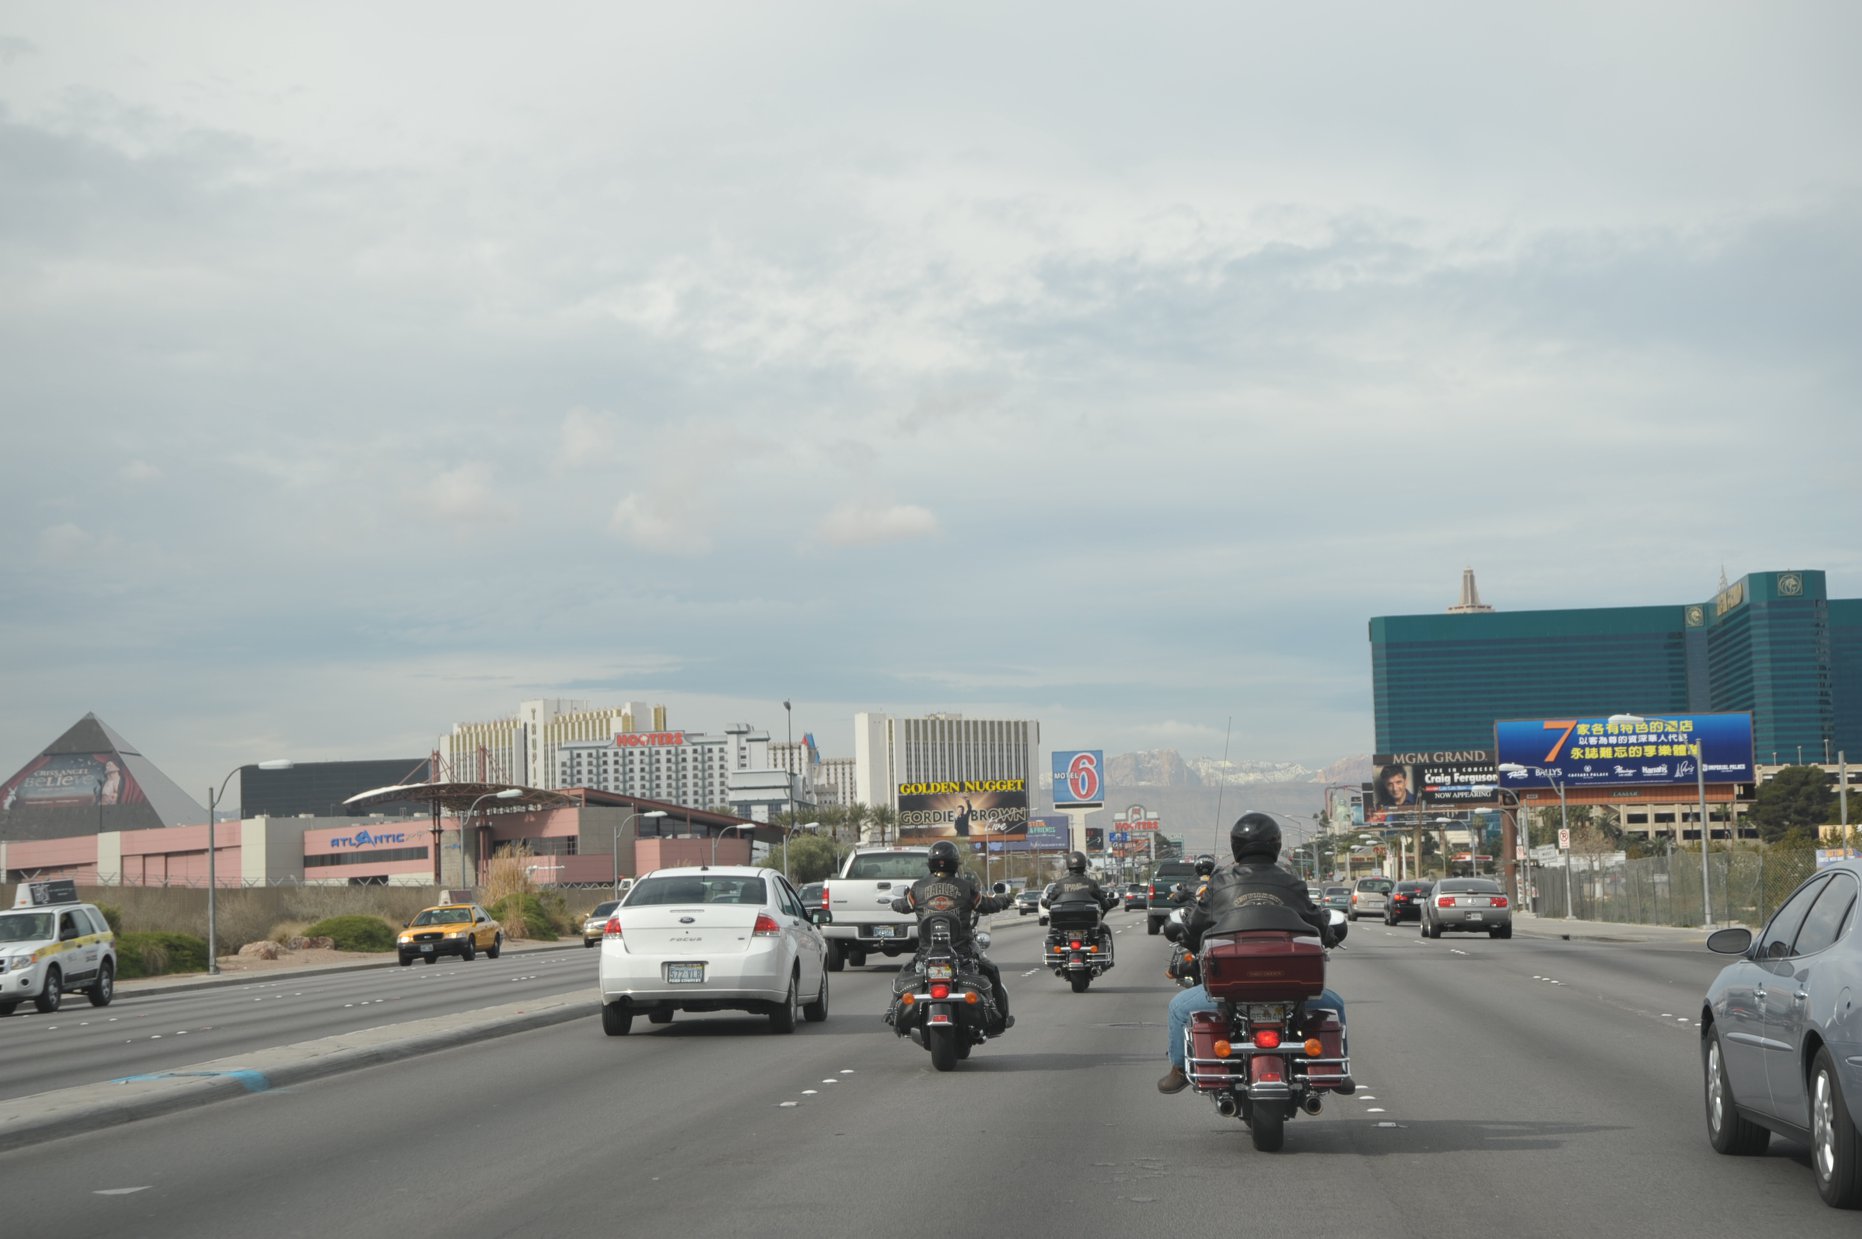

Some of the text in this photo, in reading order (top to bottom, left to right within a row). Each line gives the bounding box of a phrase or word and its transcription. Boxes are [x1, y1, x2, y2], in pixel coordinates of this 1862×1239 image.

[616, 732, 683, 747] HOOTERS
[1543, 719, 1578, 762] 7
[1392, 750, 1486, 765] MGM GRAND
[1068, 752, 1099, 801] 6
[1424, 774, 1451, 785] Craig
[900, 779, 1024, 795] GOLDEN NUGGET
[901, 806, 1026, 825] GORDIE BROWN
[984, 816, 1008, 832] Live
[1114, 821, 1159, 830] HOOTERS
[330, 830, 405, 848] ATLANTIC
